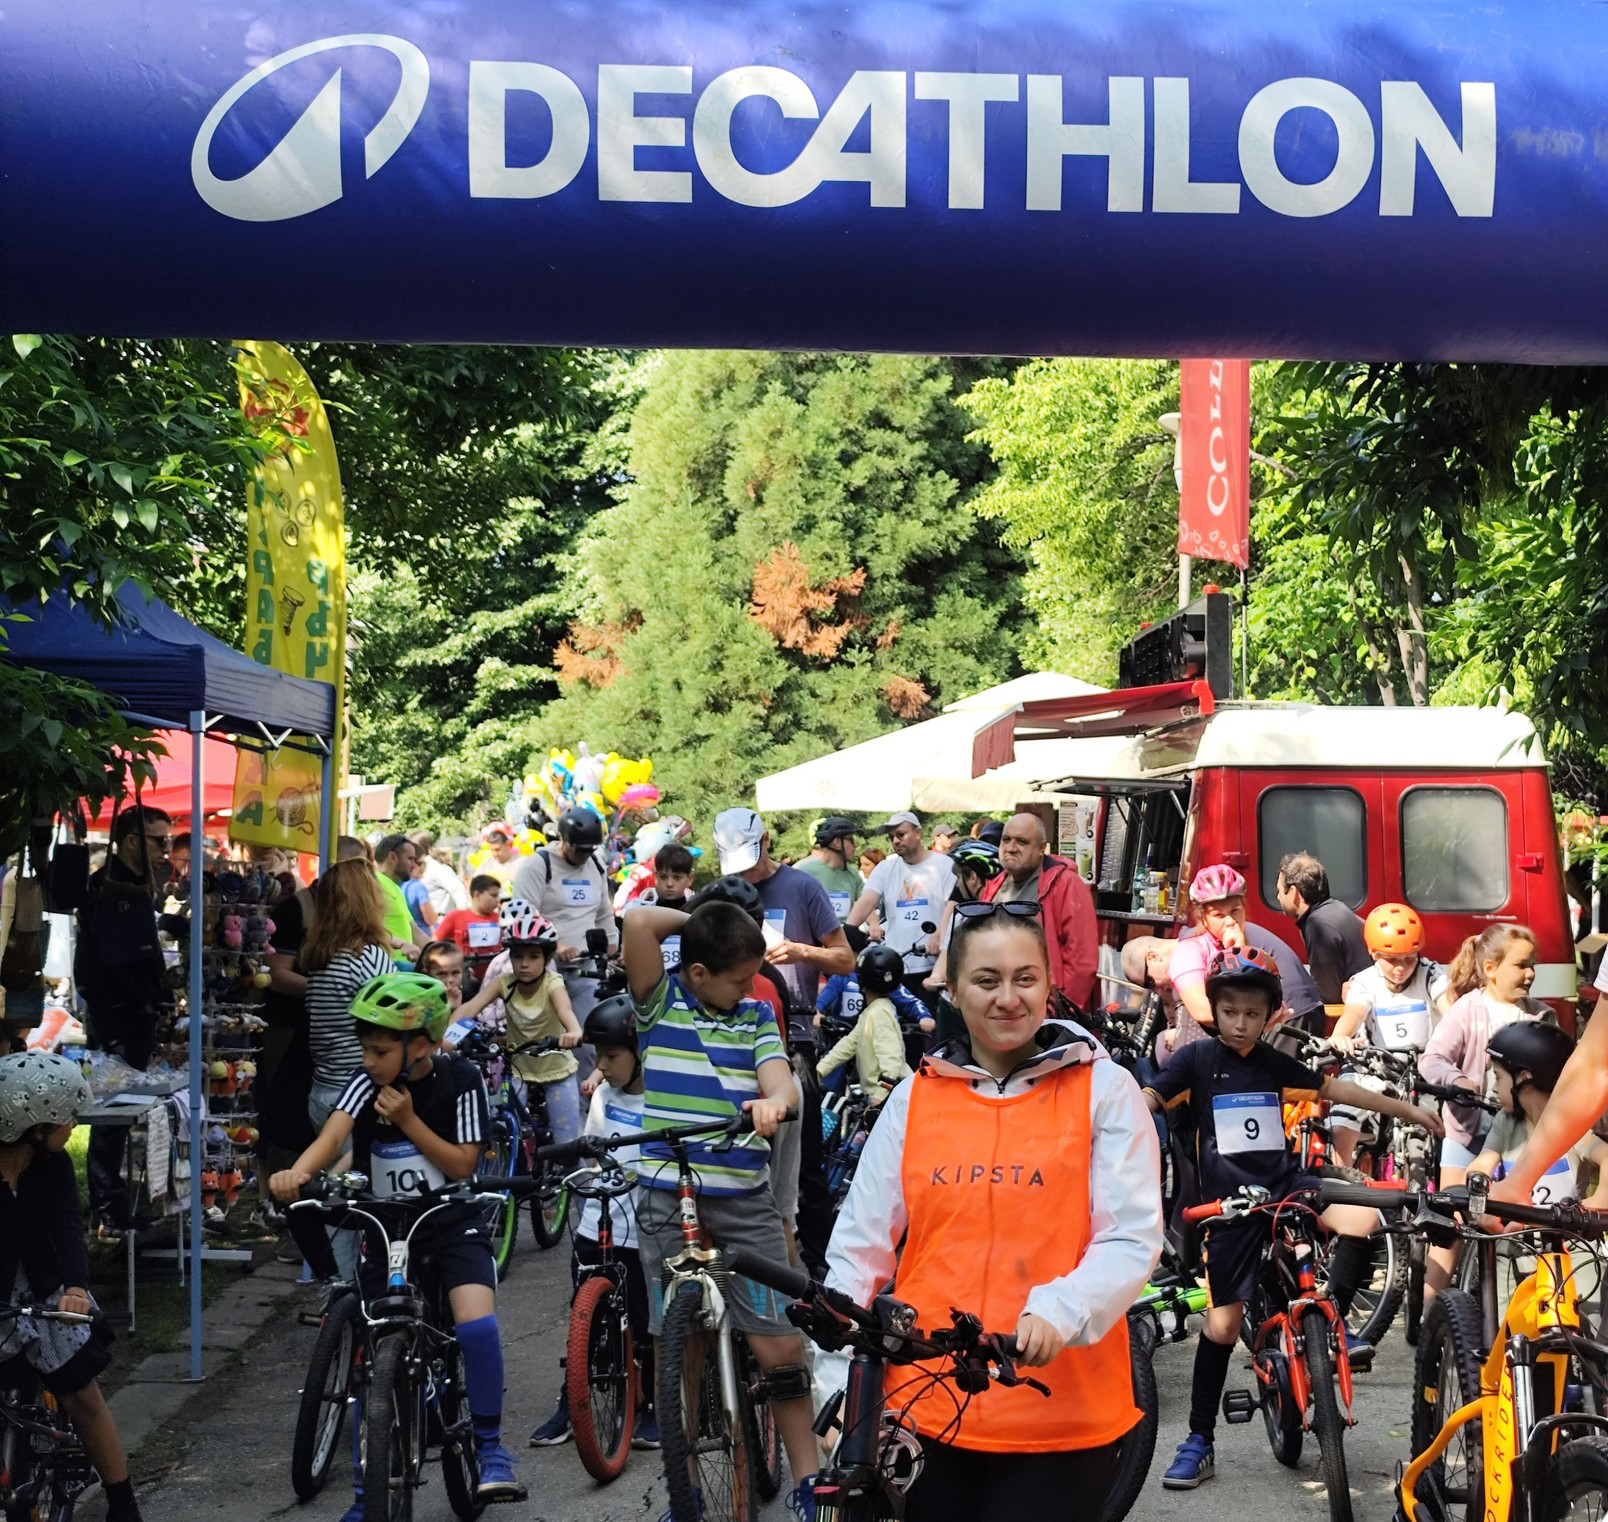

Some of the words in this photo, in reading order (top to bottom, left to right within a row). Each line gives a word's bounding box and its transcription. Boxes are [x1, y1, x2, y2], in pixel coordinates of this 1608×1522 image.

[469, 60, 1497, 218] DECATHLON
[571, 889, 586, 900] 25
[904, 910, 919, 921] 42
[481, 931, 488, 941] 2
[662, 950, 681, 963] 68
[847, 998, 864, 1012] 69
[1395, 1022, 1408, 1039] 5
[1244, 1117, 1260, 1141] 9
[931, 1164, 1045, 1187] KIPSTA
[1531, 1186, 1554, 1206] 2
